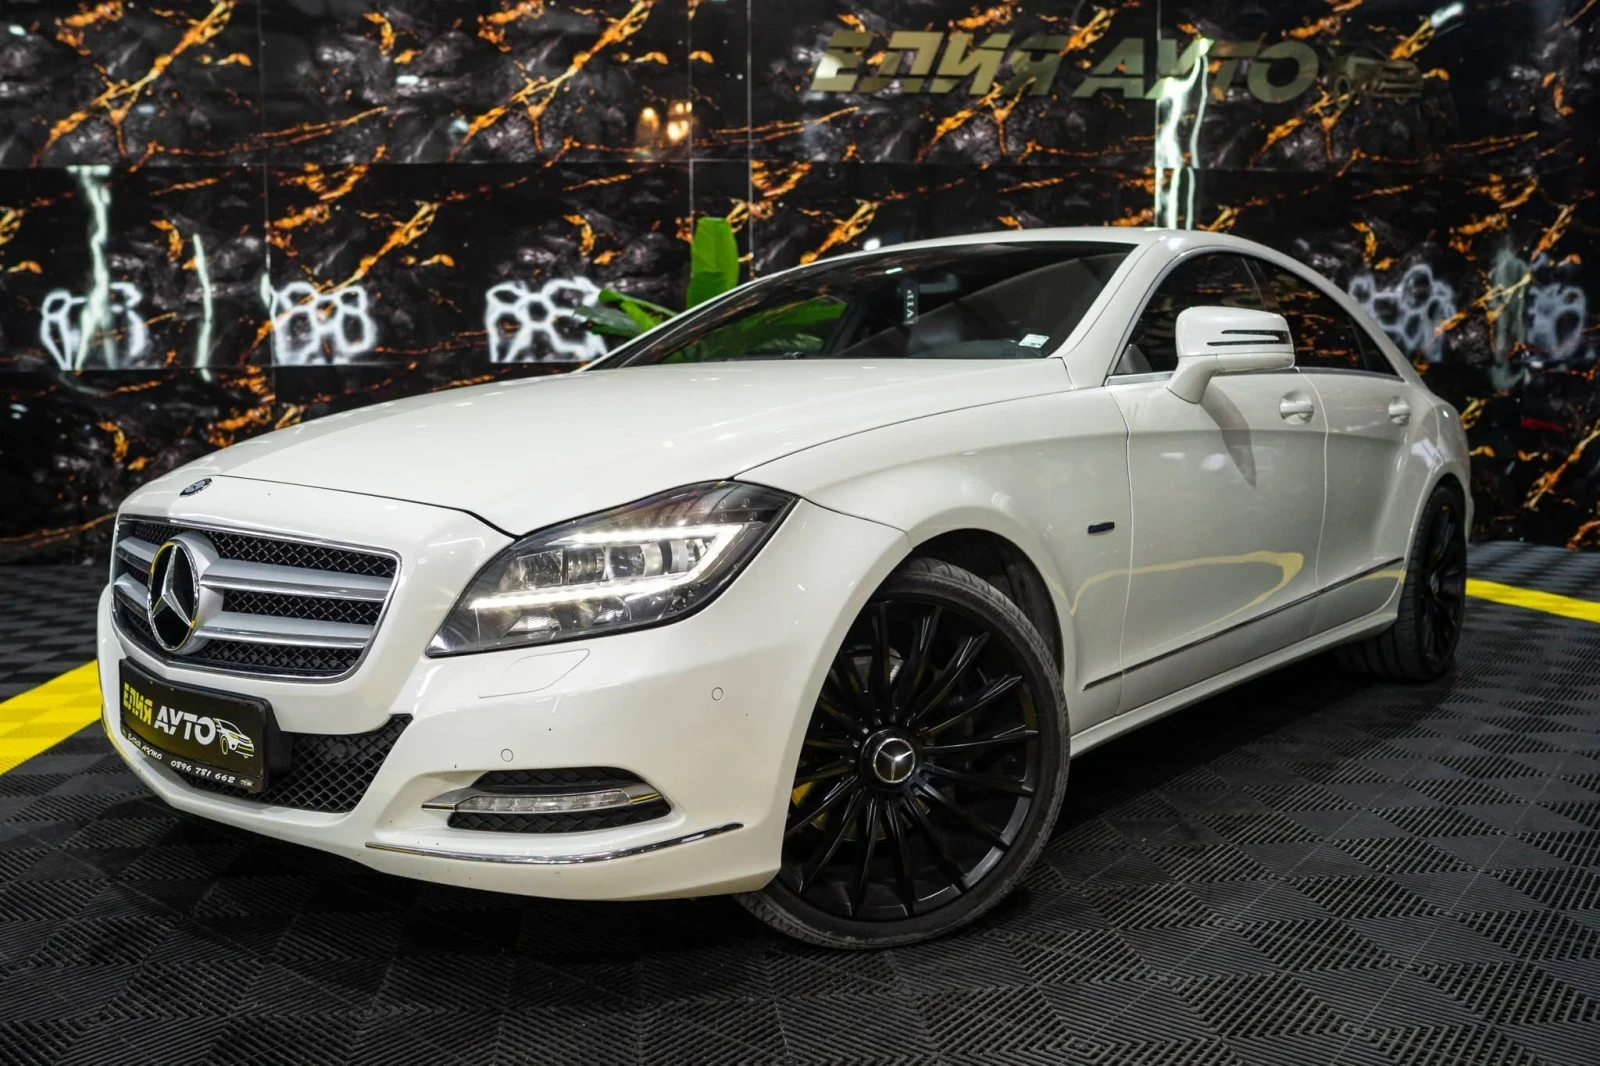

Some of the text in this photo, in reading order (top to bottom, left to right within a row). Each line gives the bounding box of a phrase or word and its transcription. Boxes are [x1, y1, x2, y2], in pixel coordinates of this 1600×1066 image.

[170, 760, 236, 784] 0896 781 662
